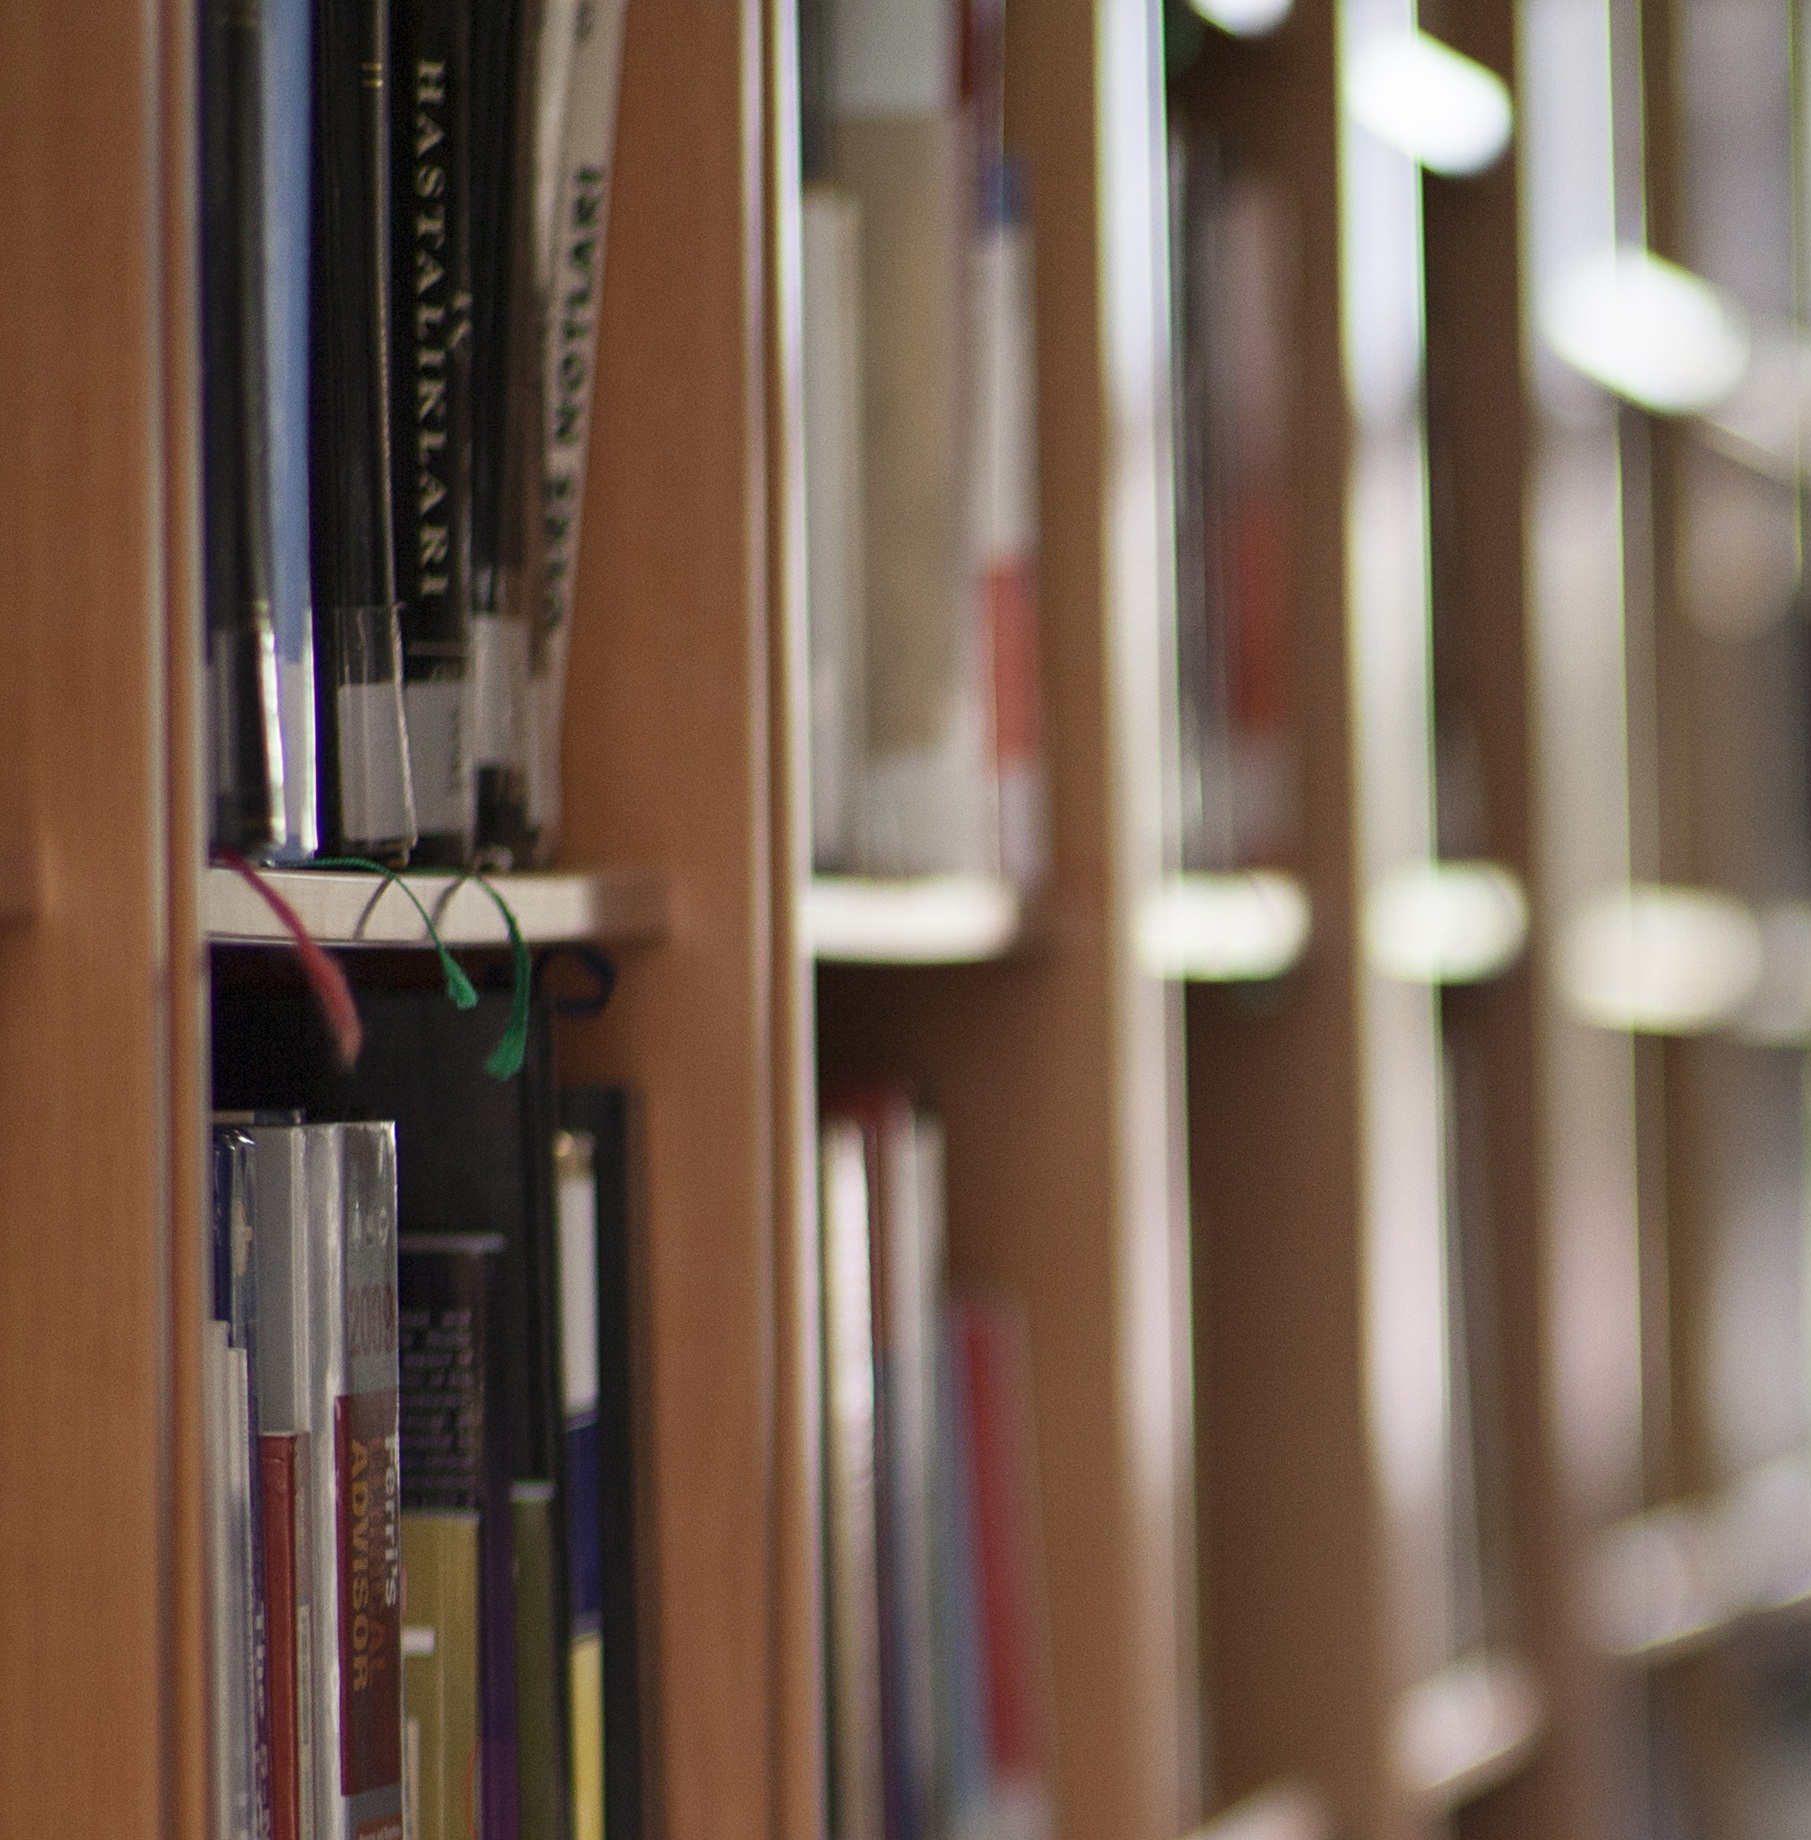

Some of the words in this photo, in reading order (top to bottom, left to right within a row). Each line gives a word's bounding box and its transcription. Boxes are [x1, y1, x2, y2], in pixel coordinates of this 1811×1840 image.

[415, 59, 447, 596] HASTALIKLARI
[555, 167, 602, 441] NOTLARI
[351, 1438, 369, 1692] ADVISOR
[383, 1433, 399, 1609] Ferri's
